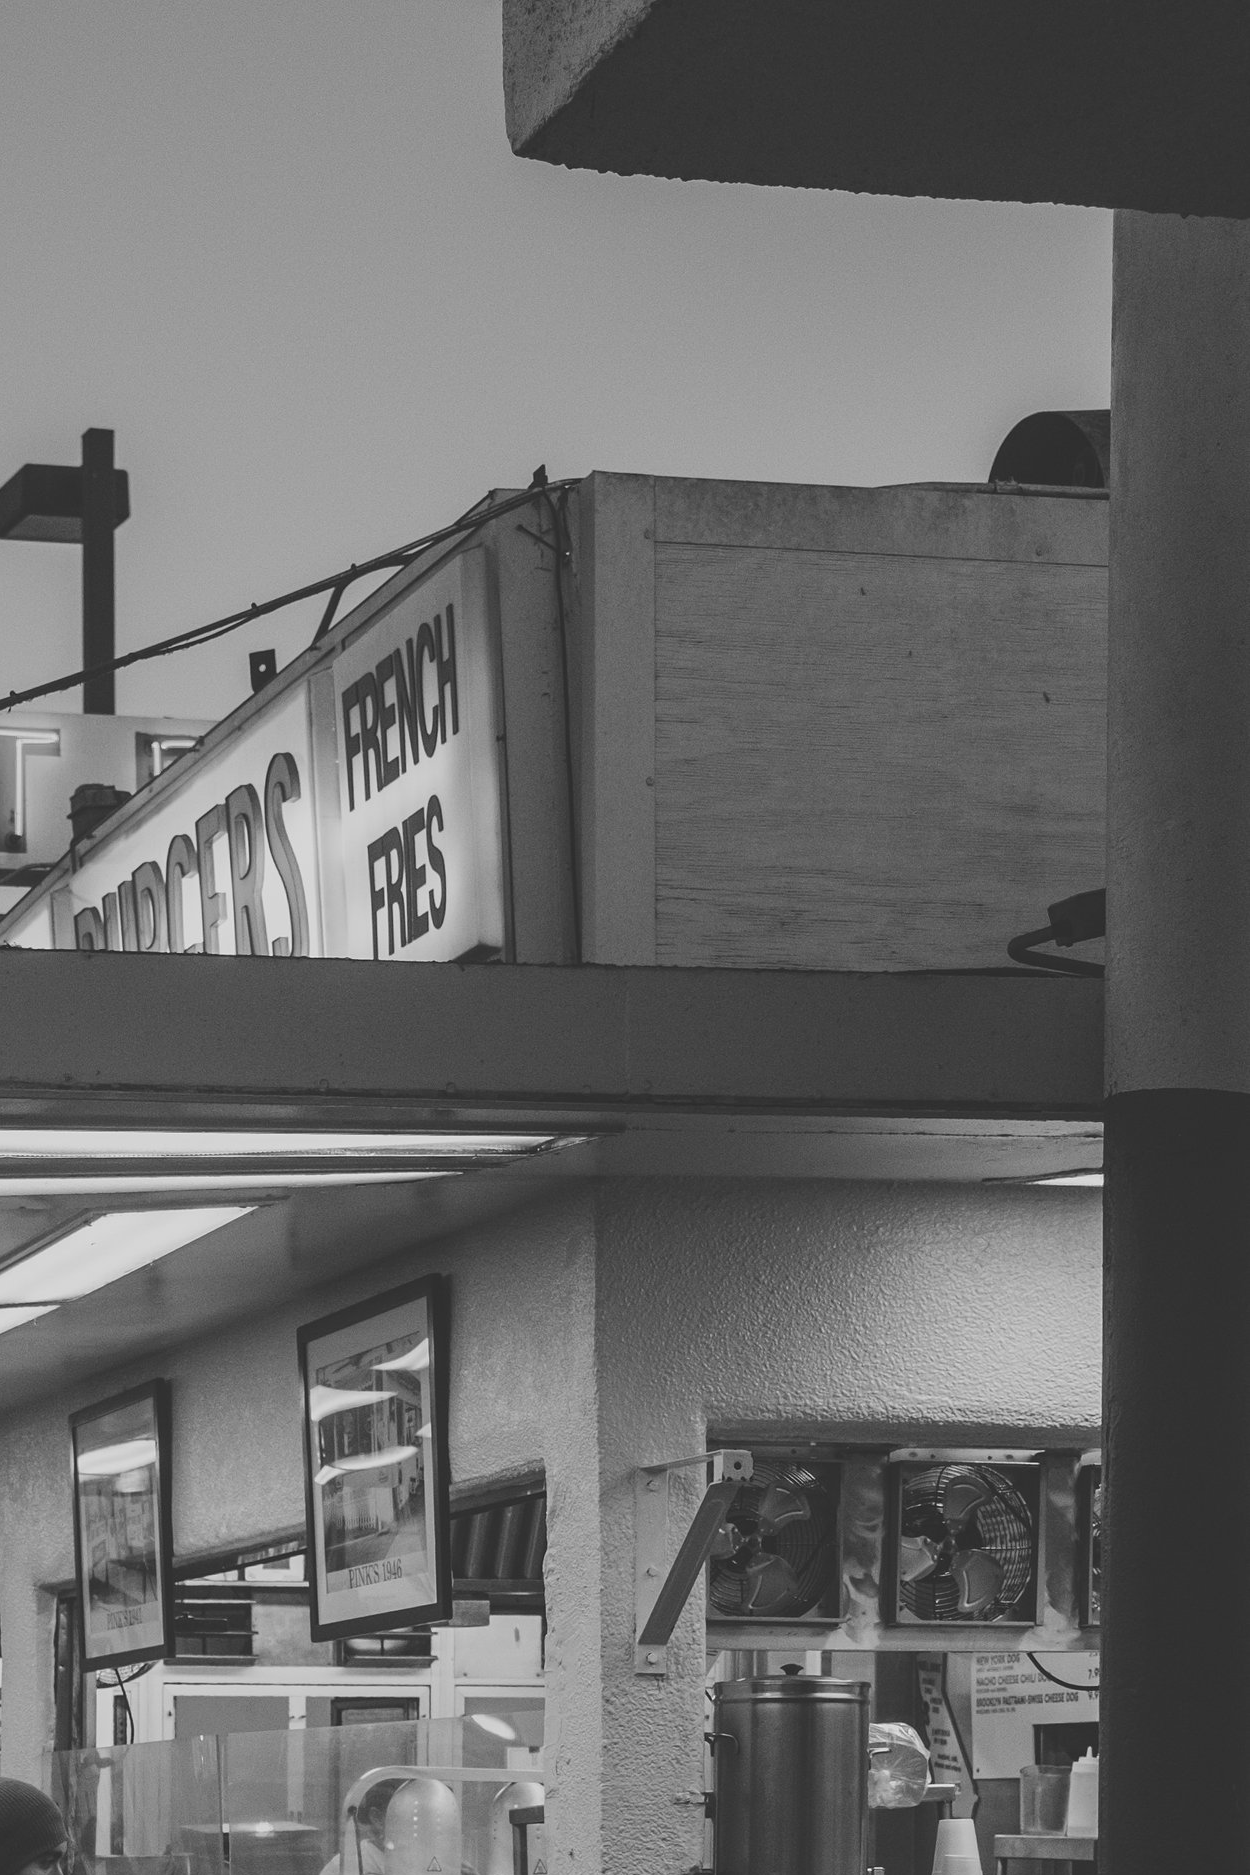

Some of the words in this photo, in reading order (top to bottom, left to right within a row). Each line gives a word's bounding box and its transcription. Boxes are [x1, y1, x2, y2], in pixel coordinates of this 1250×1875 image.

[342, 603, 459, 812] FRENCH
[367, 794, 447, 960] FRIES
[349, 1563, 380, 1589] PINK'S
[382, 1558, 403, 1582] 1946
[1007, 1653, 1020, 1664] DOG
[976, 1676, 996, 1687] NACHO
[998, 1674, 1019, 1685] CHEESE
[1044, 1693, 1065, 1703] CHEESE
[1066, 1691, 1079, 1702] DOG
